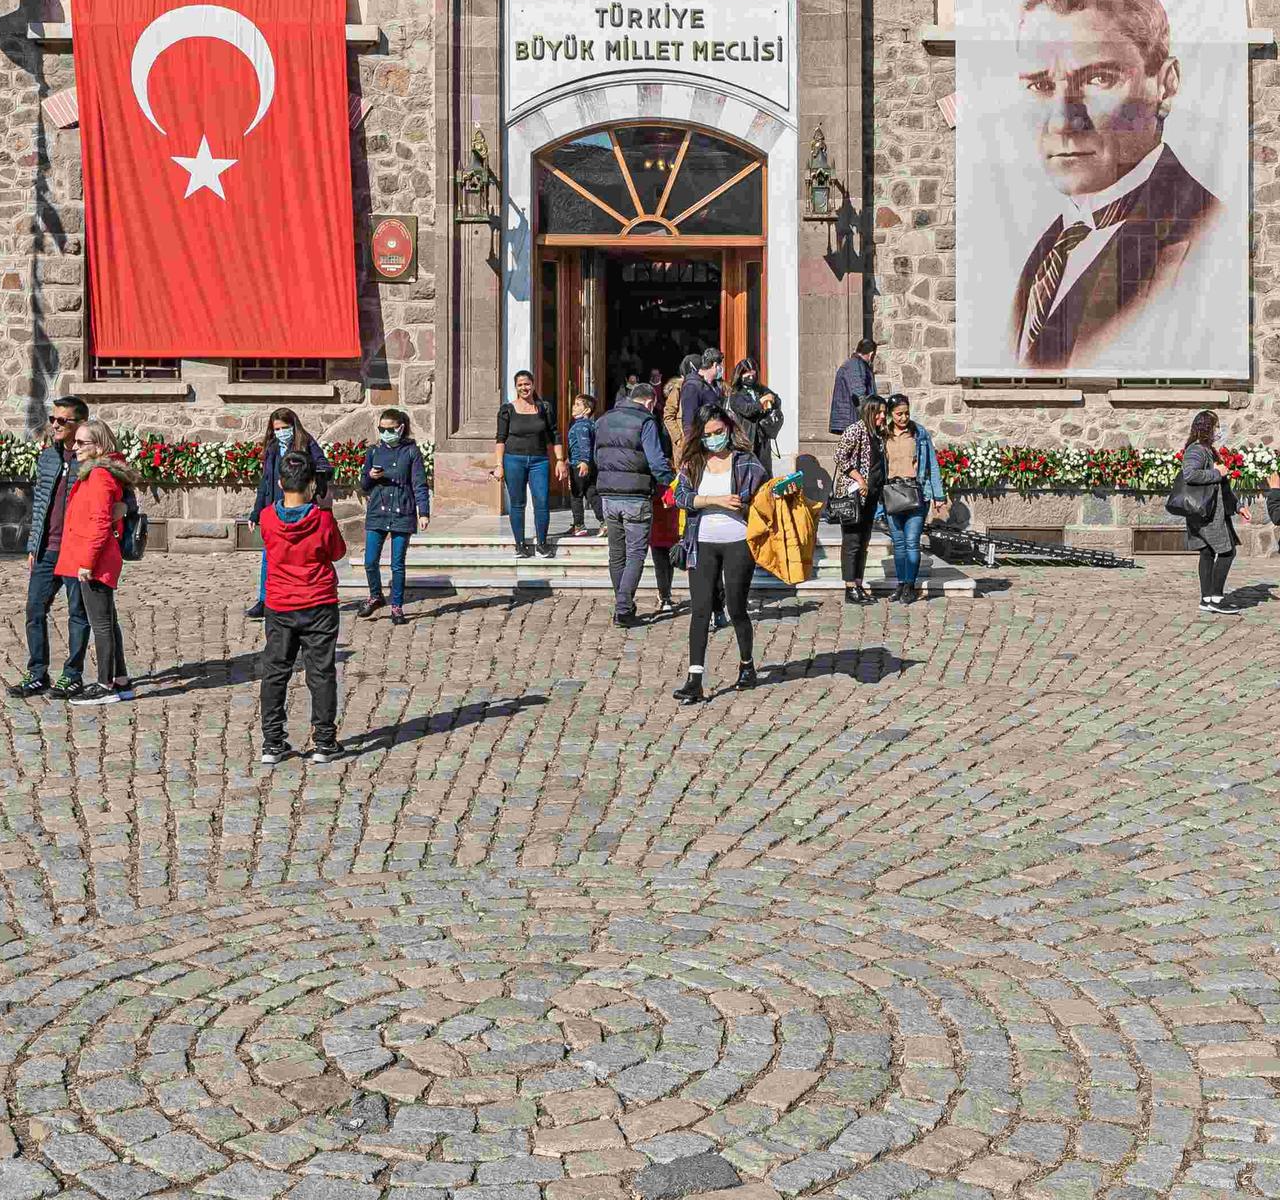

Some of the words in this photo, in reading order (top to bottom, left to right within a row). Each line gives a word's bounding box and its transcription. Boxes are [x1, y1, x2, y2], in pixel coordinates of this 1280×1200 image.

[594, 1, 706, 30] TÜRKİYE
[514, 33, 595, 63] BÜYÜK
[605, 34, 685, 63] MİLLET
[692, 35, 784, 64] MECLİSİ
